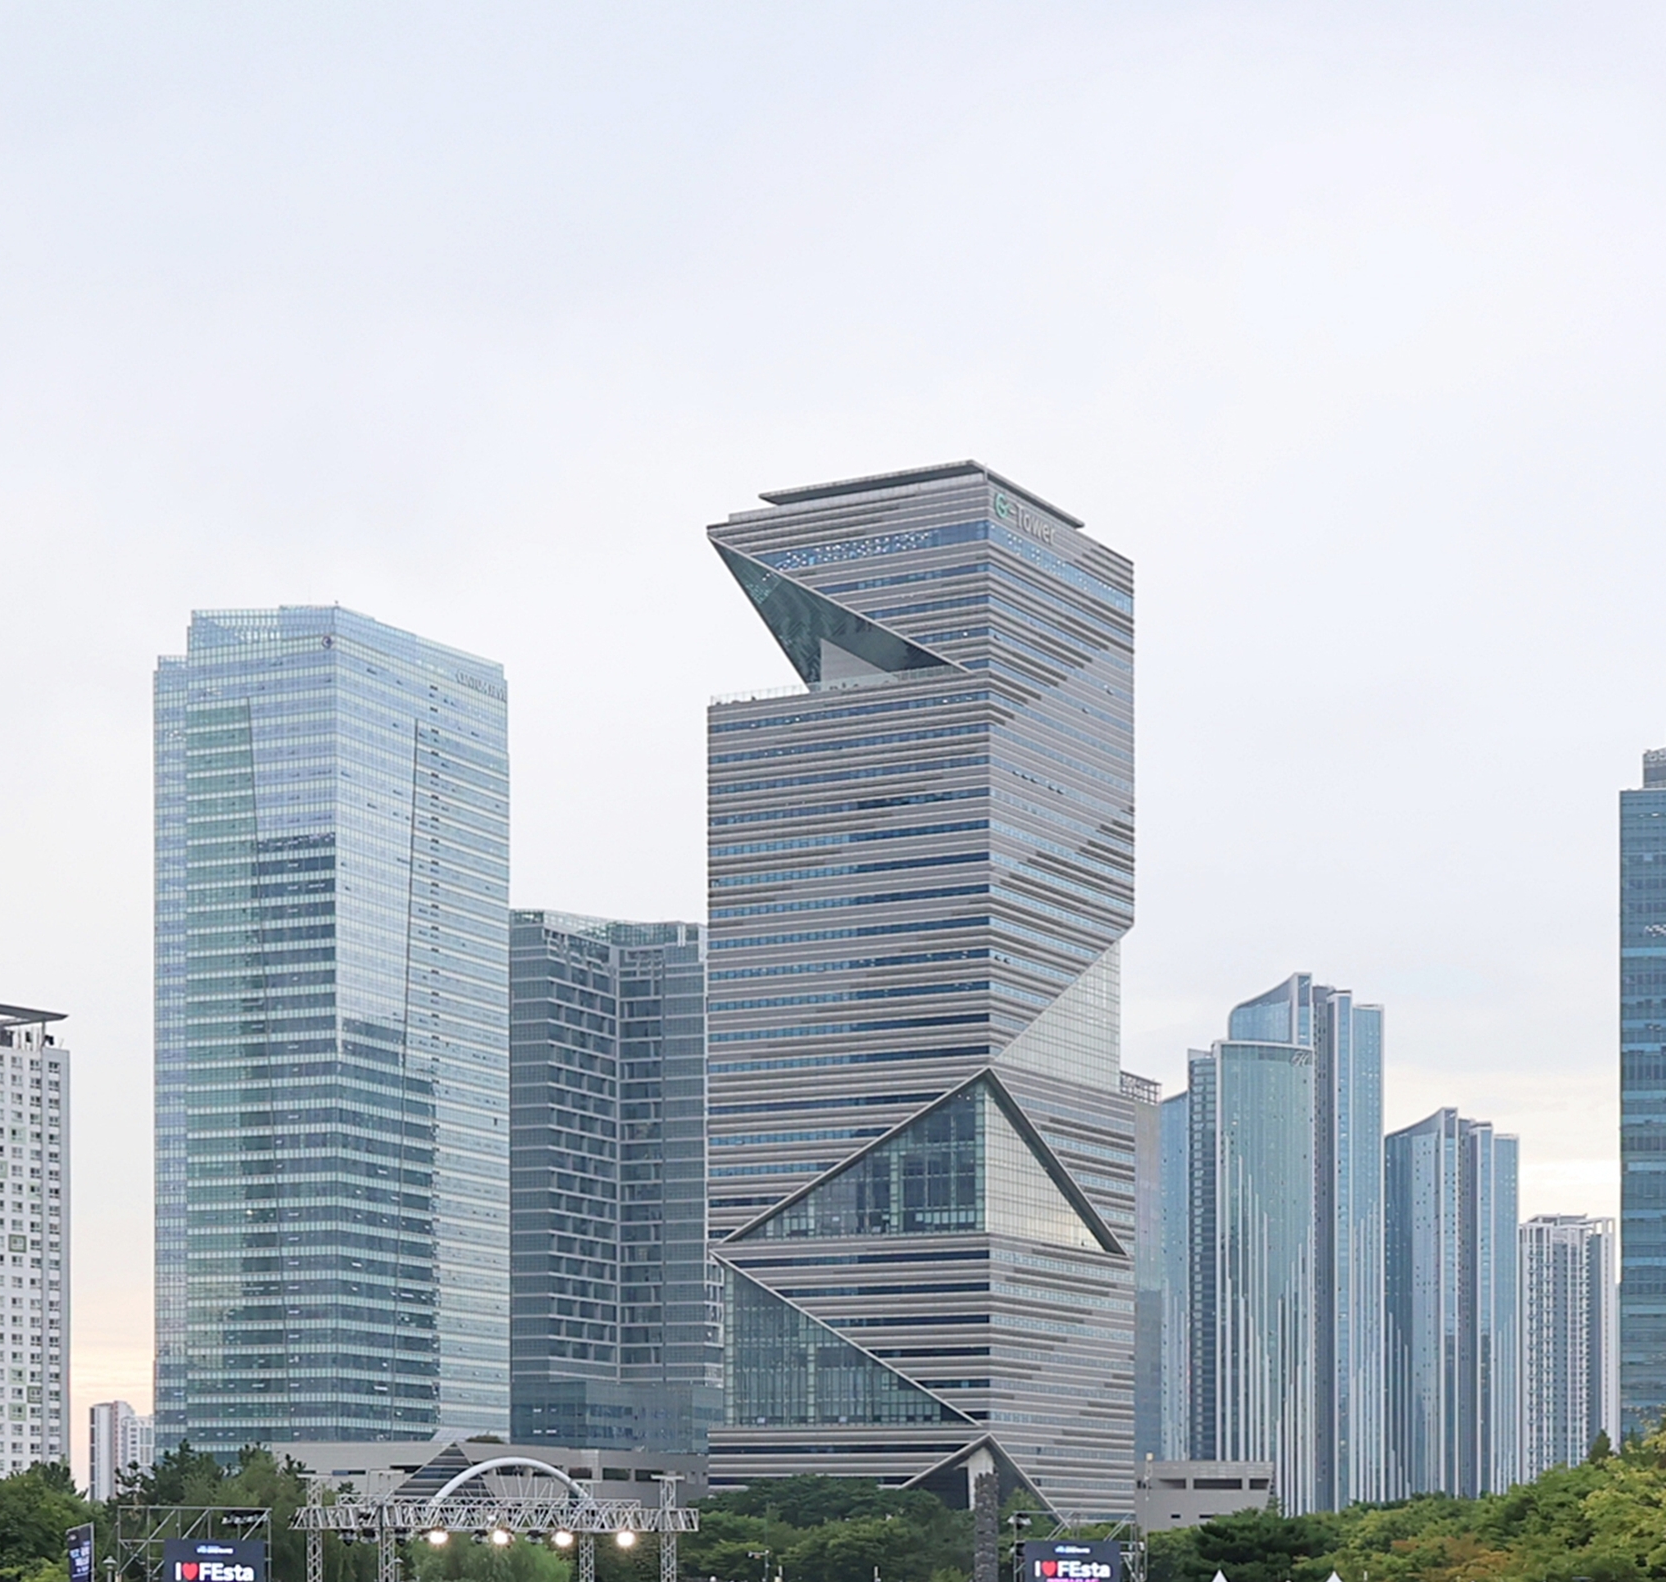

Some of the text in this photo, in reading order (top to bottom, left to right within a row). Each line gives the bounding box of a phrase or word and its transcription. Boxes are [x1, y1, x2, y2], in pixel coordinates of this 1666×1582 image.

[175, 1562, 254, 1582] I FEsta
[1035, 1560, 1111, 1578] I FEsta
